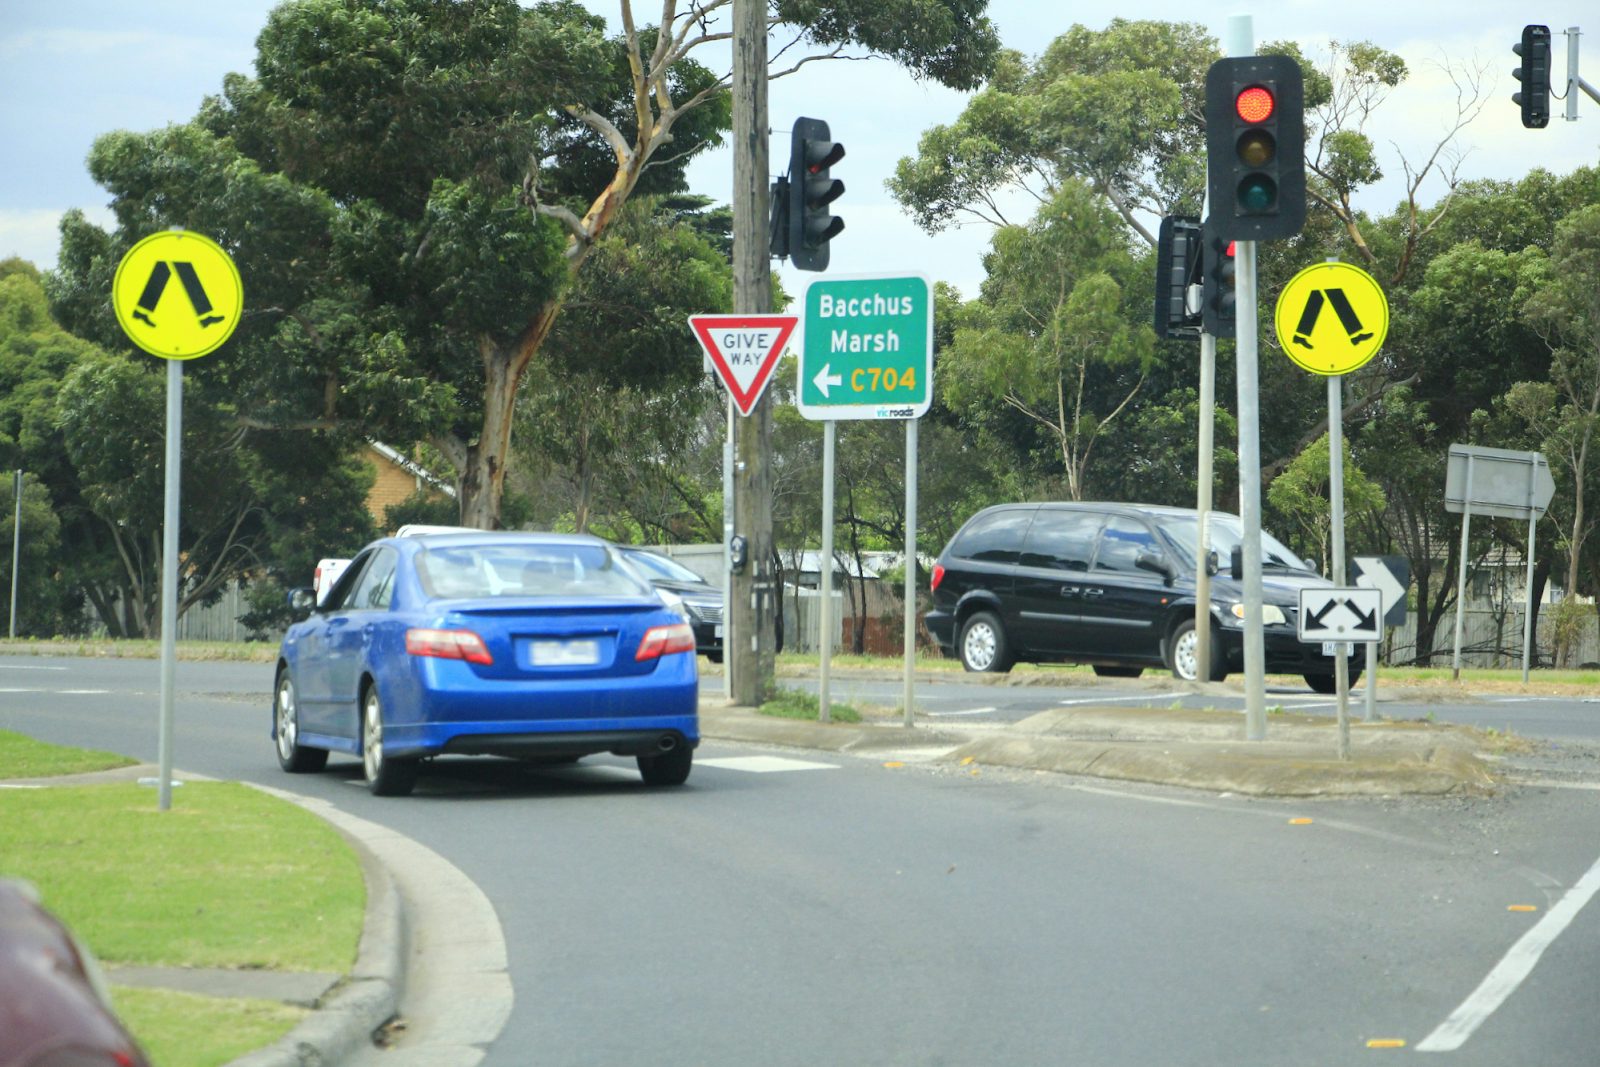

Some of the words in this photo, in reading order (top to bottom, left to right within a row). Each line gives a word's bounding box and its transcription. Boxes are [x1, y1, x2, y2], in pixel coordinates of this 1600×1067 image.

[819, 294, 913, 317] Bacchus
[723, 333, 769, 348] GIVE
[831, 329, 900, 353] Marsh
[731, 353, 763, 366] WAY
[851, 367, 916, 392] C704
